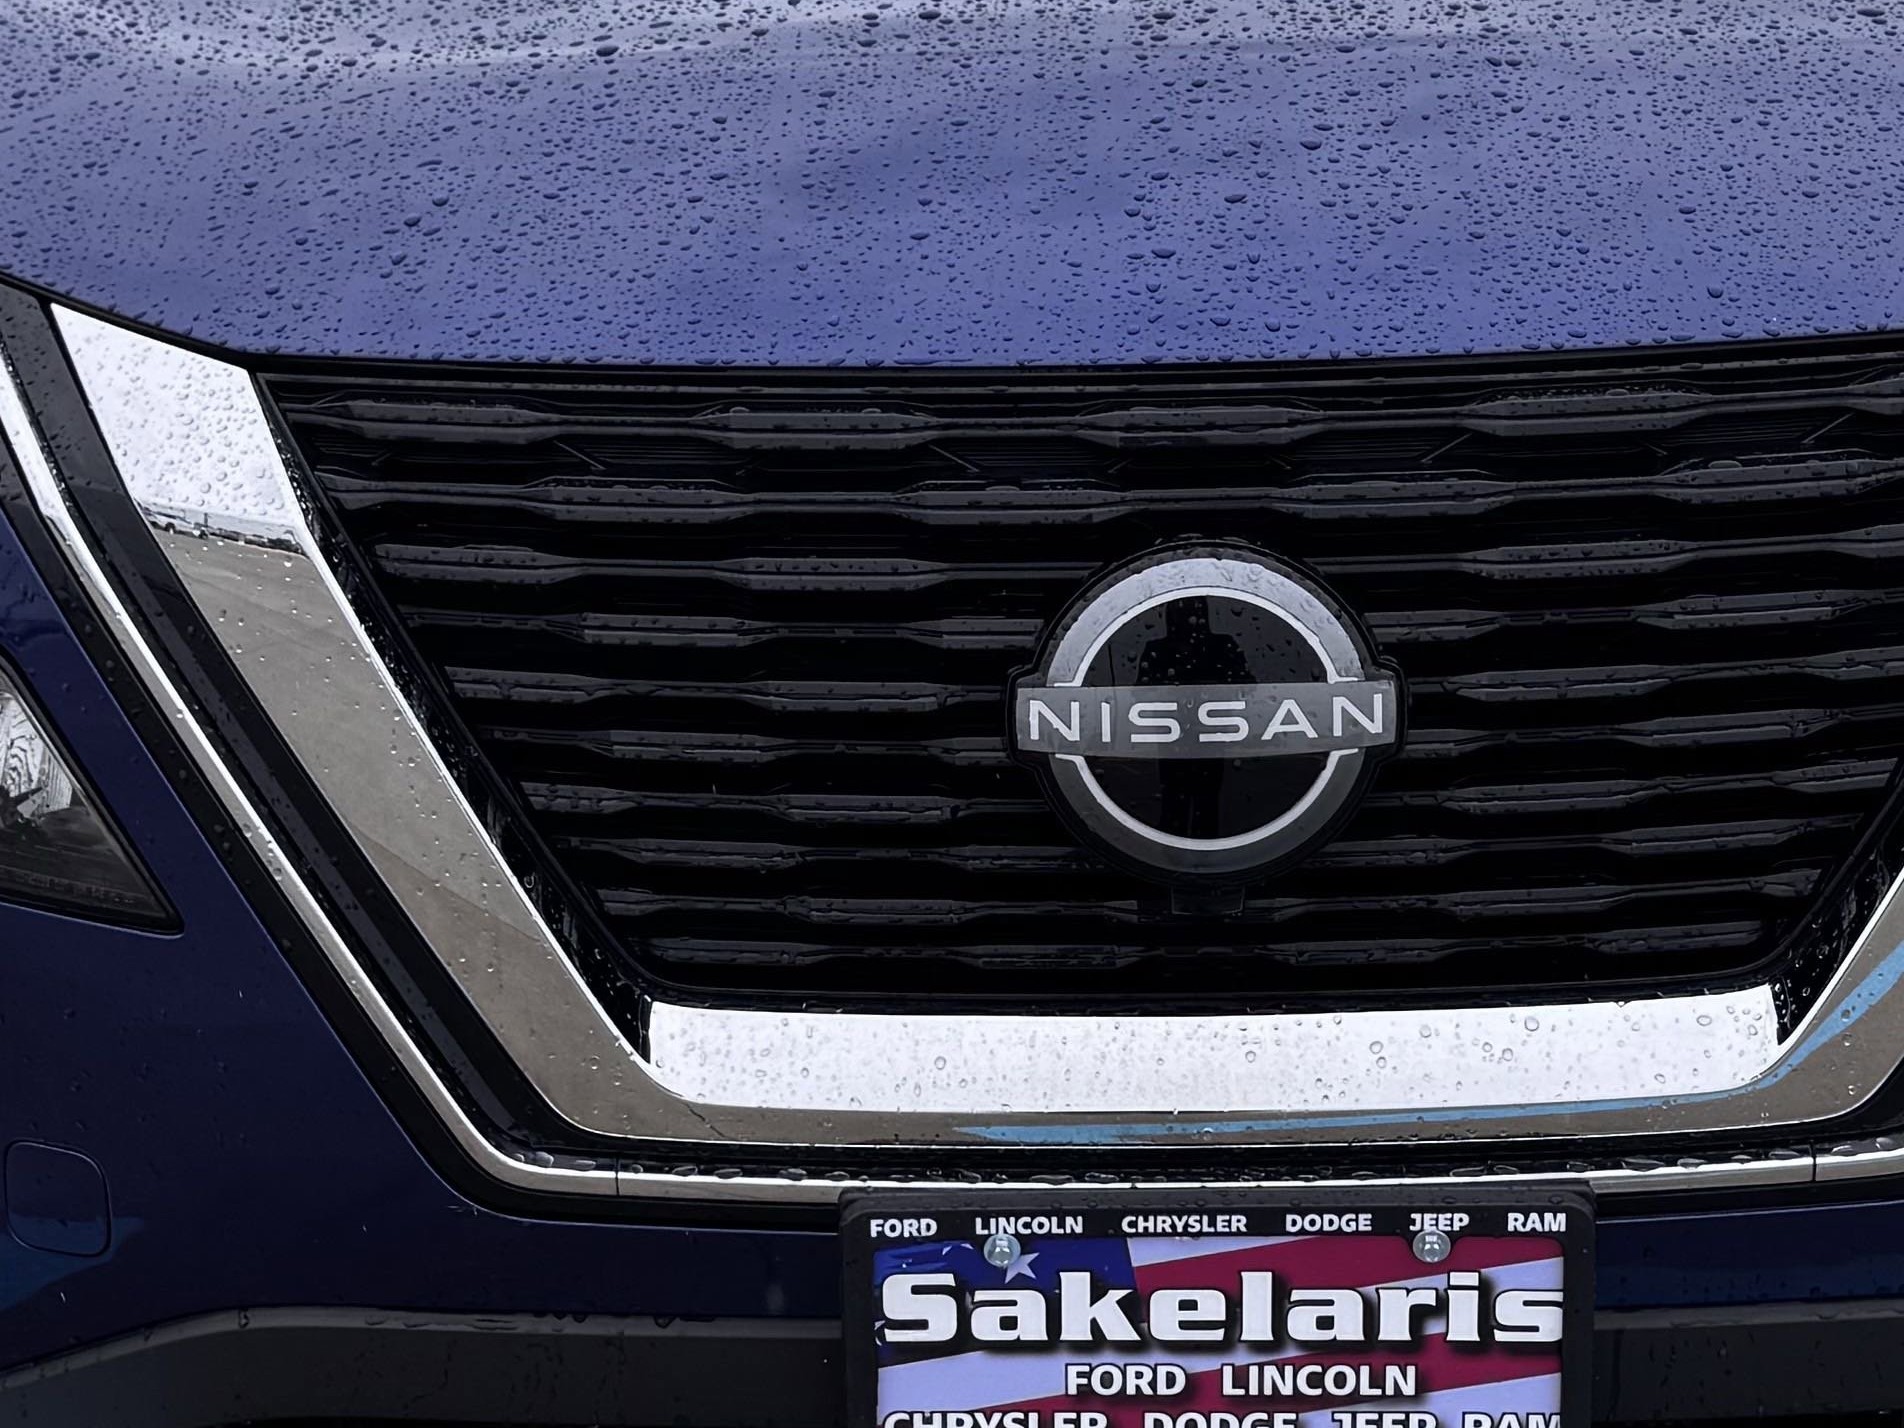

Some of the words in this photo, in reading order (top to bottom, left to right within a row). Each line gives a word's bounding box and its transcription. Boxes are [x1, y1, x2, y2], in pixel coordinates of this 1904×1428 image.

[1028, 693, 1384, 743] NISSAN
[869, 1218, 938, 1238] FORD
[975, 1215, 1084, 1235] LINCOLN
[1121, 1214, 1248, 1234] CHRYSLER
[1285, 1213, 1373, 1233] DODGE
[1409, 1212, 1470, 1232] JEEP
[1507, 1212, 1567, 1233] RAM
[881, 1271, 1564, 1343] Sakelaris
[1067, 1364, 1186, 1396] FORD
[1222, 1364, 1417, 1397] LINCOLN
